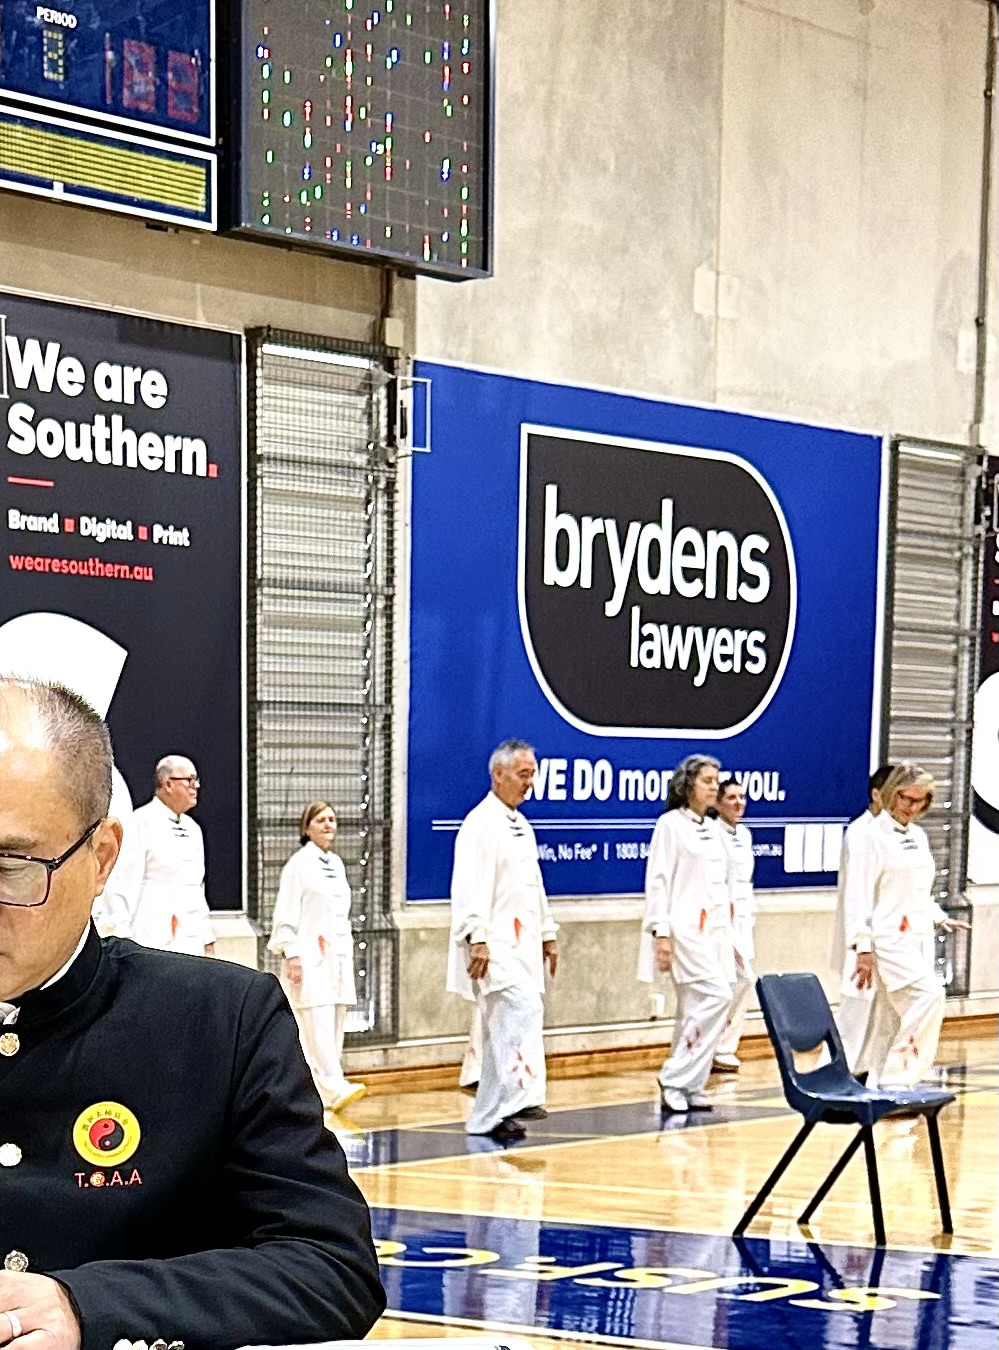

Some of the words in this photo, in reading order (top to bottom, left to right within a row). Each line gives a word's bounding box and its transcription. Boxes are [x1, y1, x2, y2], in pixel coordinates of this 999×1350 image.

[36, 6, 77, 29] PERIOD
[5, 335, 85, 397] We
[93, 361, 168, 409] are
[6, 401, 219, 478] Southern.
[7, 509, 59, 534] Brand
[79, 515, 134, 543] Digital
[152, 524, 190, 547] Print
[543, 483, 772, 617] brydens
[8, 555, 154, 581] wearesouthern.au
[629, 605, 767, 687] lawyers
[573, 758, 613, 801] DO
[618, 768, 675, 801] mor
